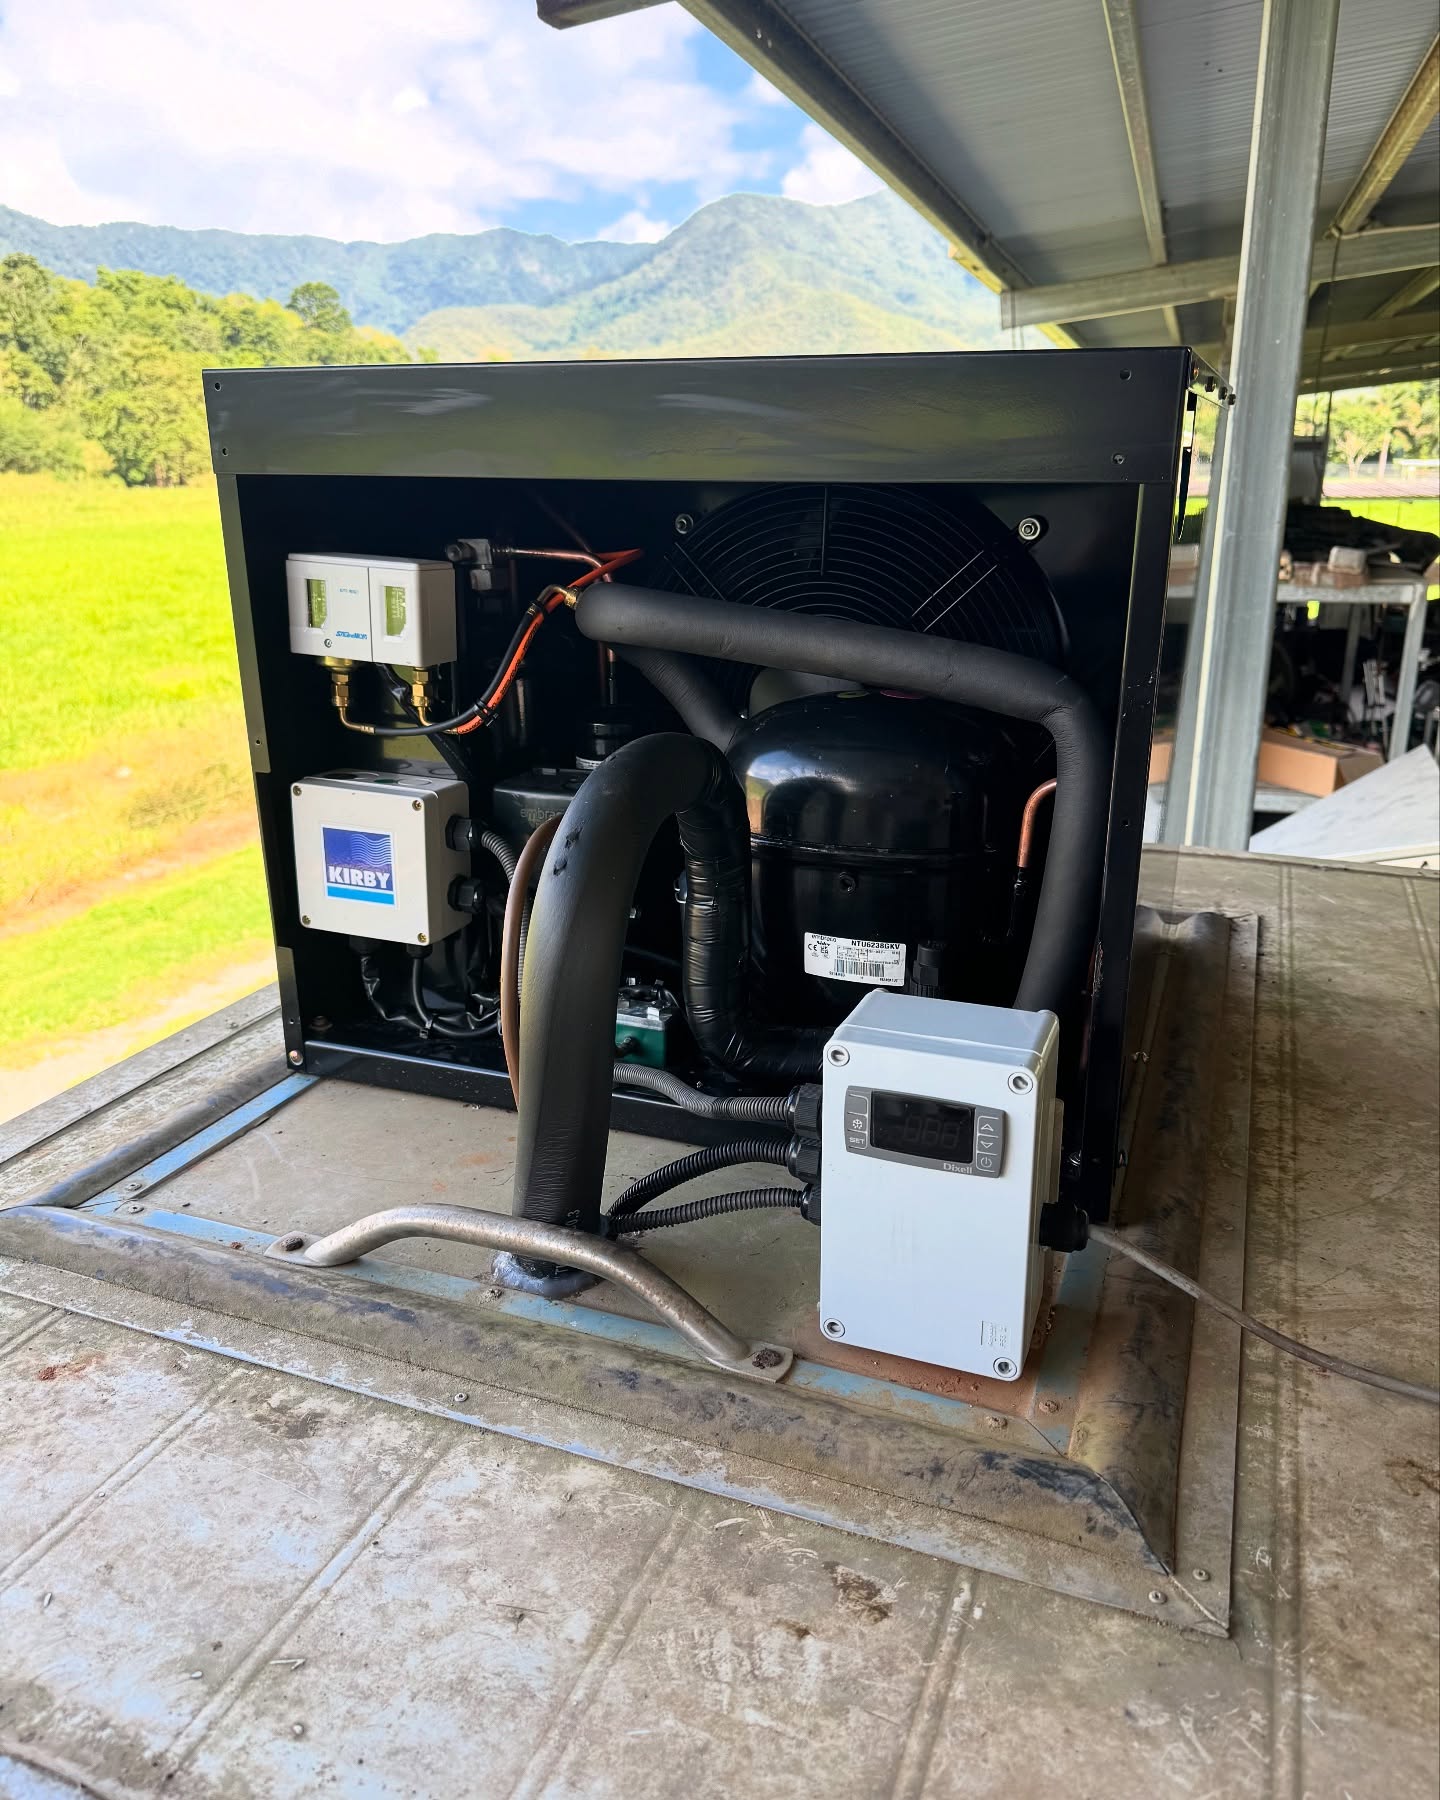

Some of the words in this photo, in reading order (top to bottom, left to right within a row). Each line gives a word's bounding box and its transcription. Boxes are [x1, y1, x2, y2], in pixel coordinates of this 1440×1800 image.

[328, 866, 390, 888] KIRBY
[851, 940, 900, 950] NTU6238GKV
[849, 1136, 865, 1145] SET
[943, 1162, 973, 1174] Dixell
